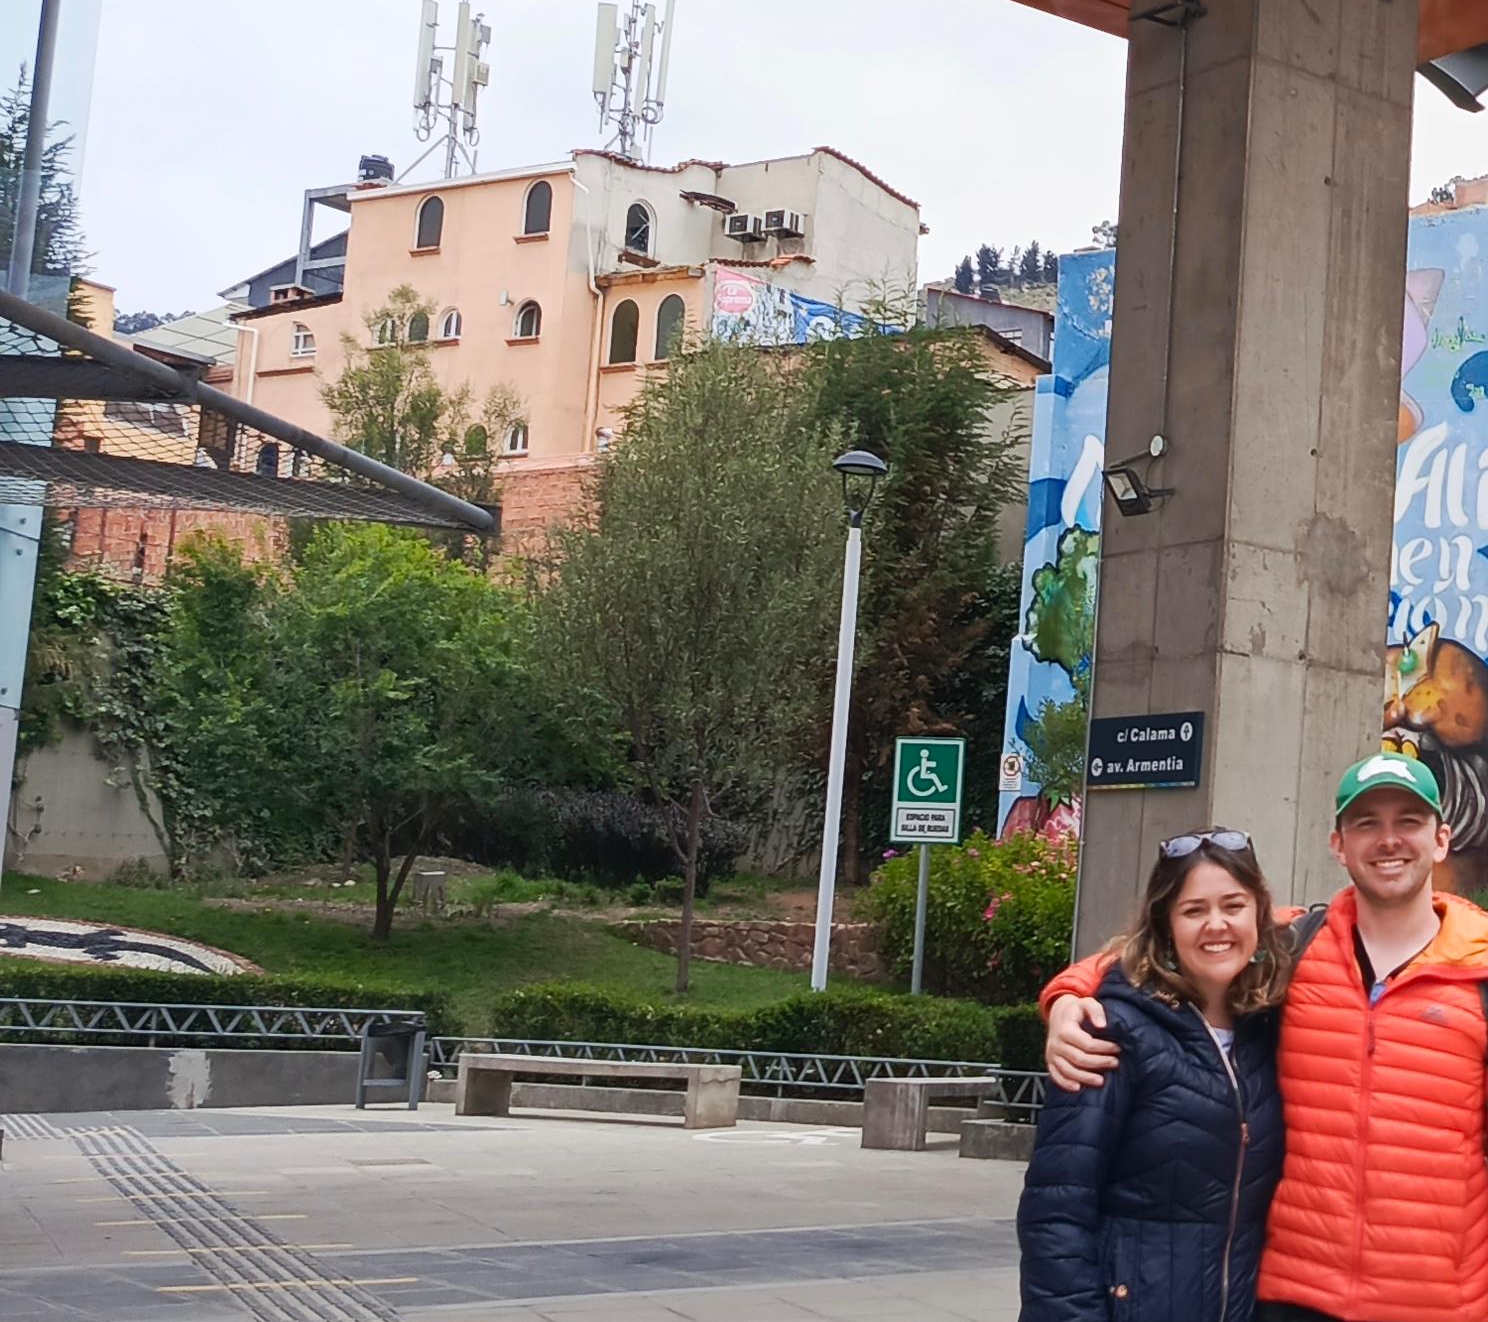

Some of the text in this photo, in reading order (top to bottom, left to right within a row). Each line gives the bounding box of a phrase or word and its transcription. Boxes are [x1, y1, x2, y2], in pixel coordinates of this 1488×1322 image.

[1116, 727, 1176, 743] c/ Calama
[1106, 755, 1184, 774] av. Armentia
